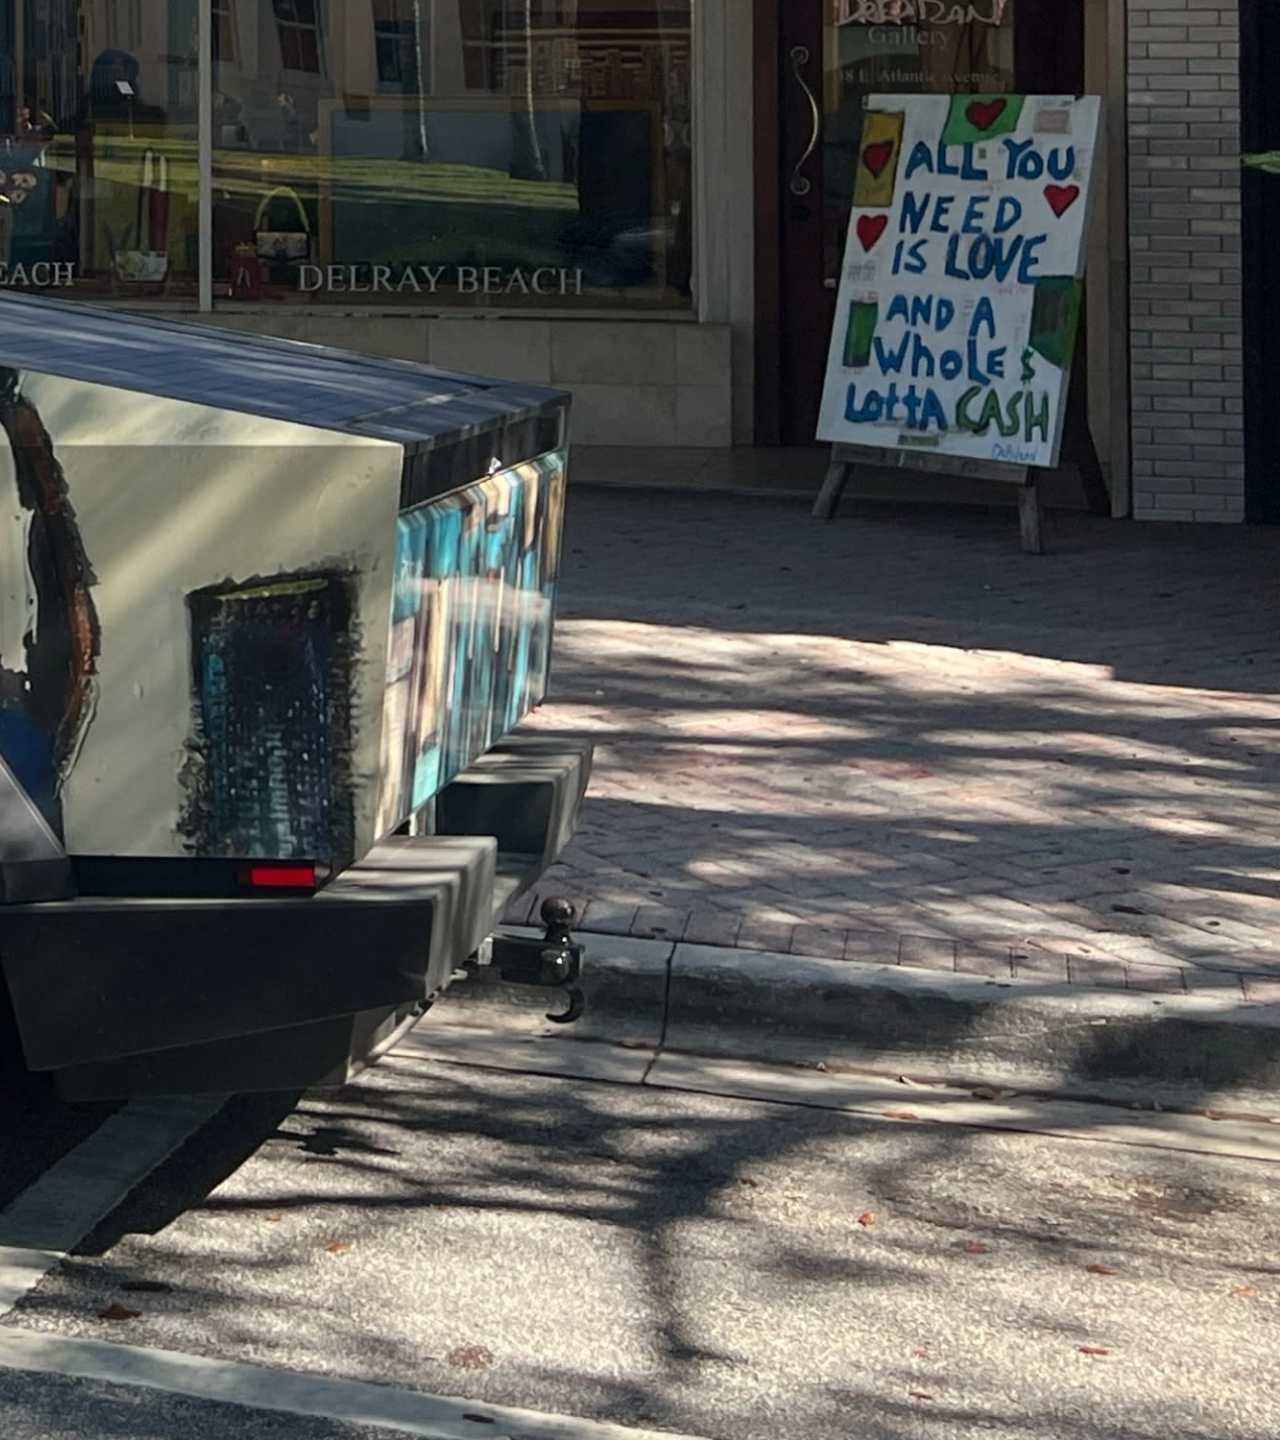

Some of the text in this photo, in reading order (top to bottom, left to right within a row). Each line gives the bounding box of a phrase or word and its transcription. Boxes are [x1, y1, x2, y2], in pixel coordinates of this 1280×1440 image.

[868, 27, 954, 47] Gallery
[904, 139, 988, 181] ALL
[899, 192, 1023, 234] NEED
[299, 264, 584, 295] DELRAY BEACH
[892, 233, 1048, 285] IS LOVE
[886, 294, 997, 339] AND A
[955, 385, 1051, 444] CASH
